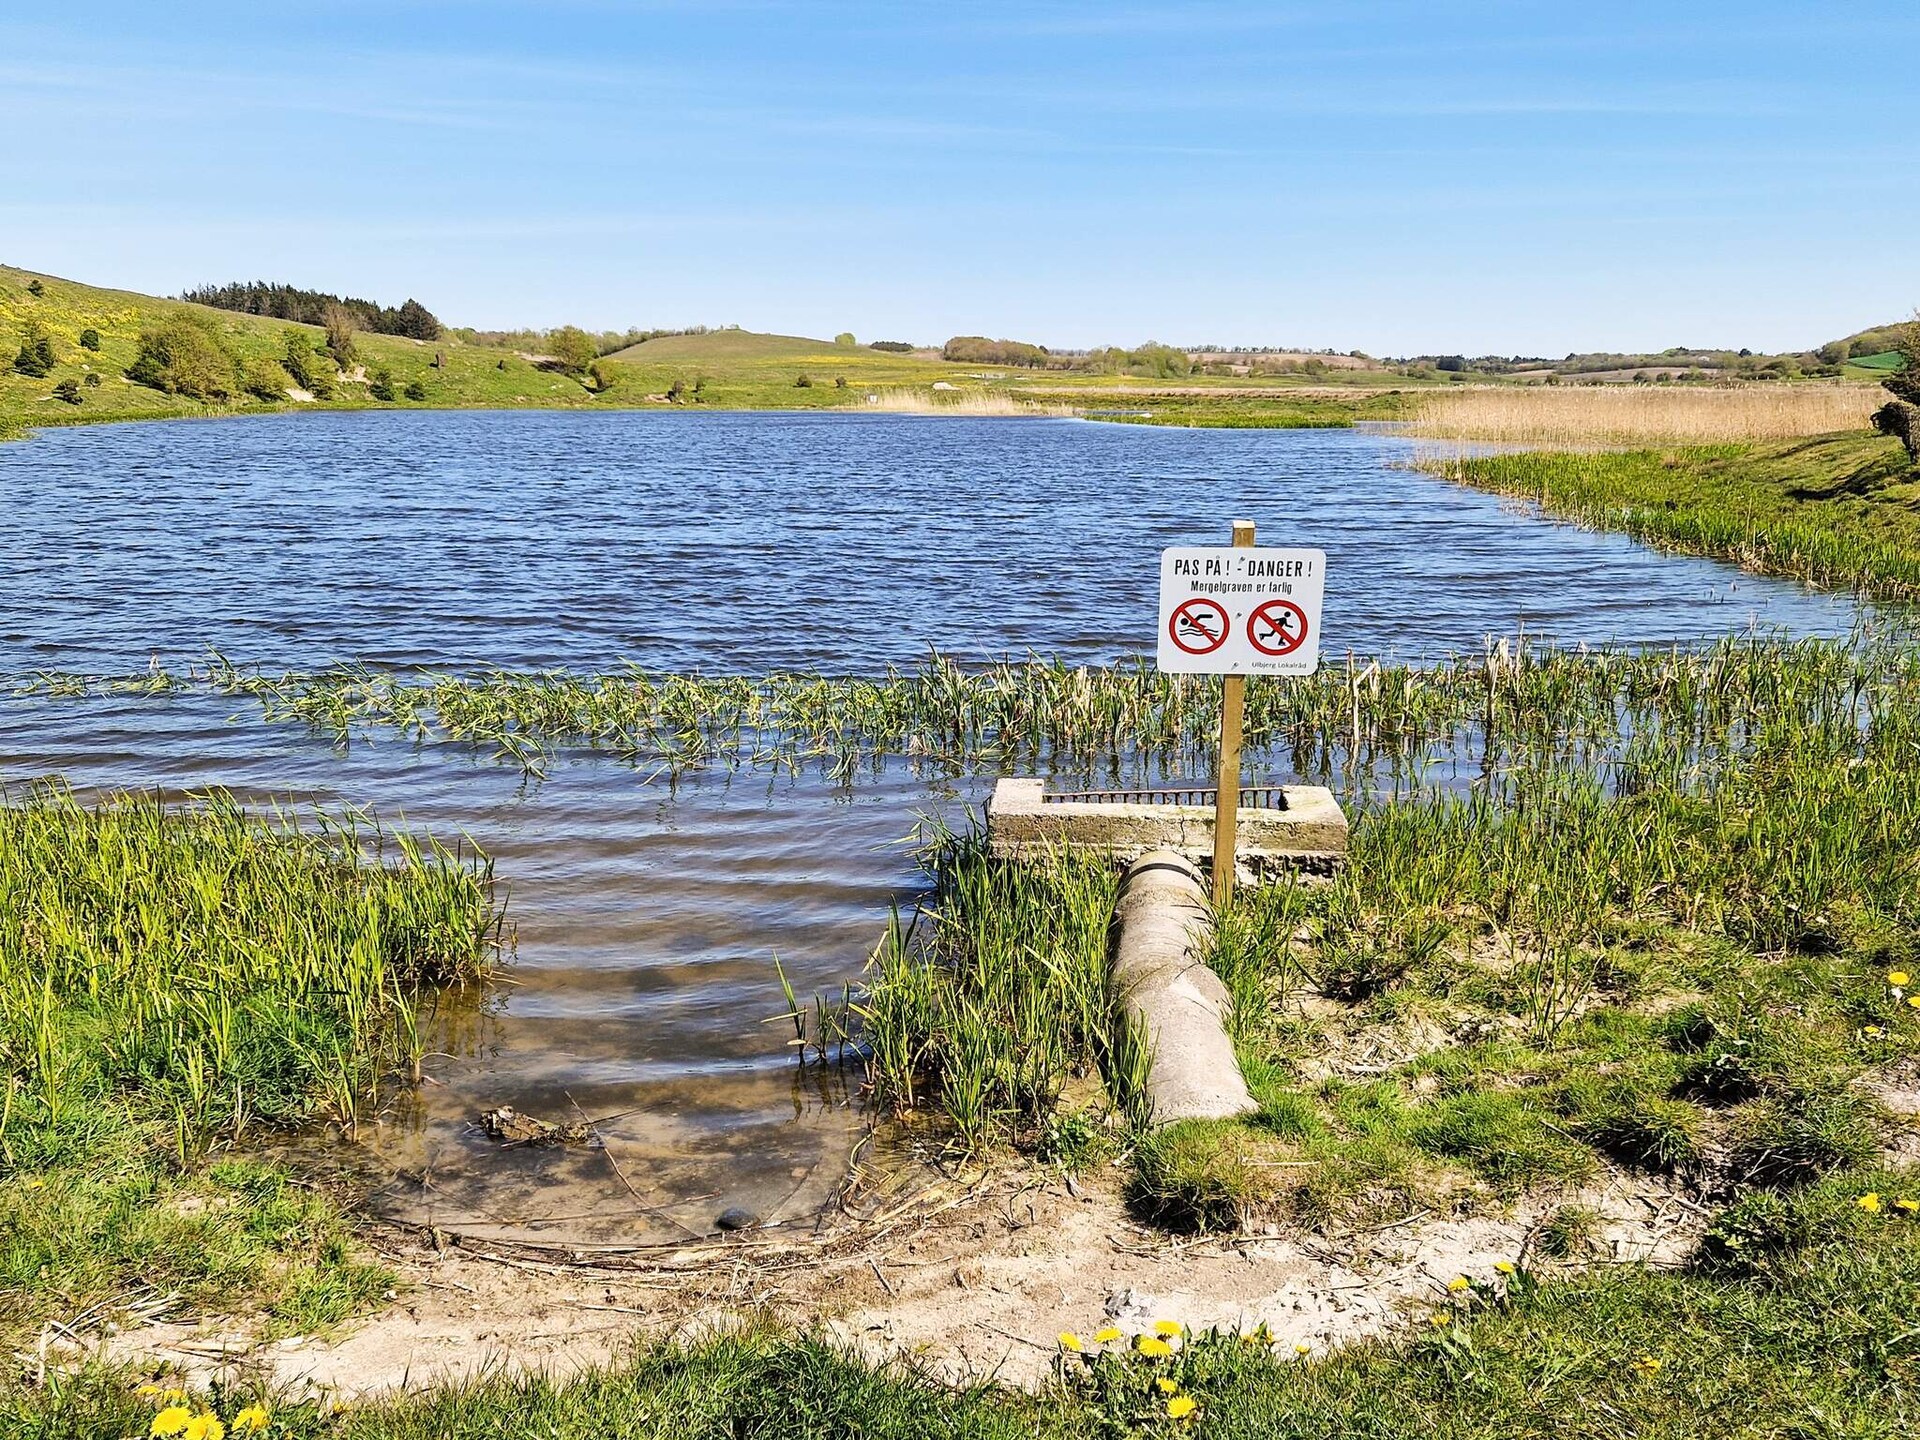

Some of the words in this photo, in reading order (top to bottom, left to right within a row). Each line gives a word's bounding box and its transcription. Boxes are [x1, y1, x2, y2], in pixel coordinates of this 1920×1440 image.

[1174, 559, 1200, 575] PAS
[1190, 580, 1253, 594] Mergelgraven
[1256, 583, 1266, 593] er
[1269, 581, 1292, 595] farlig
